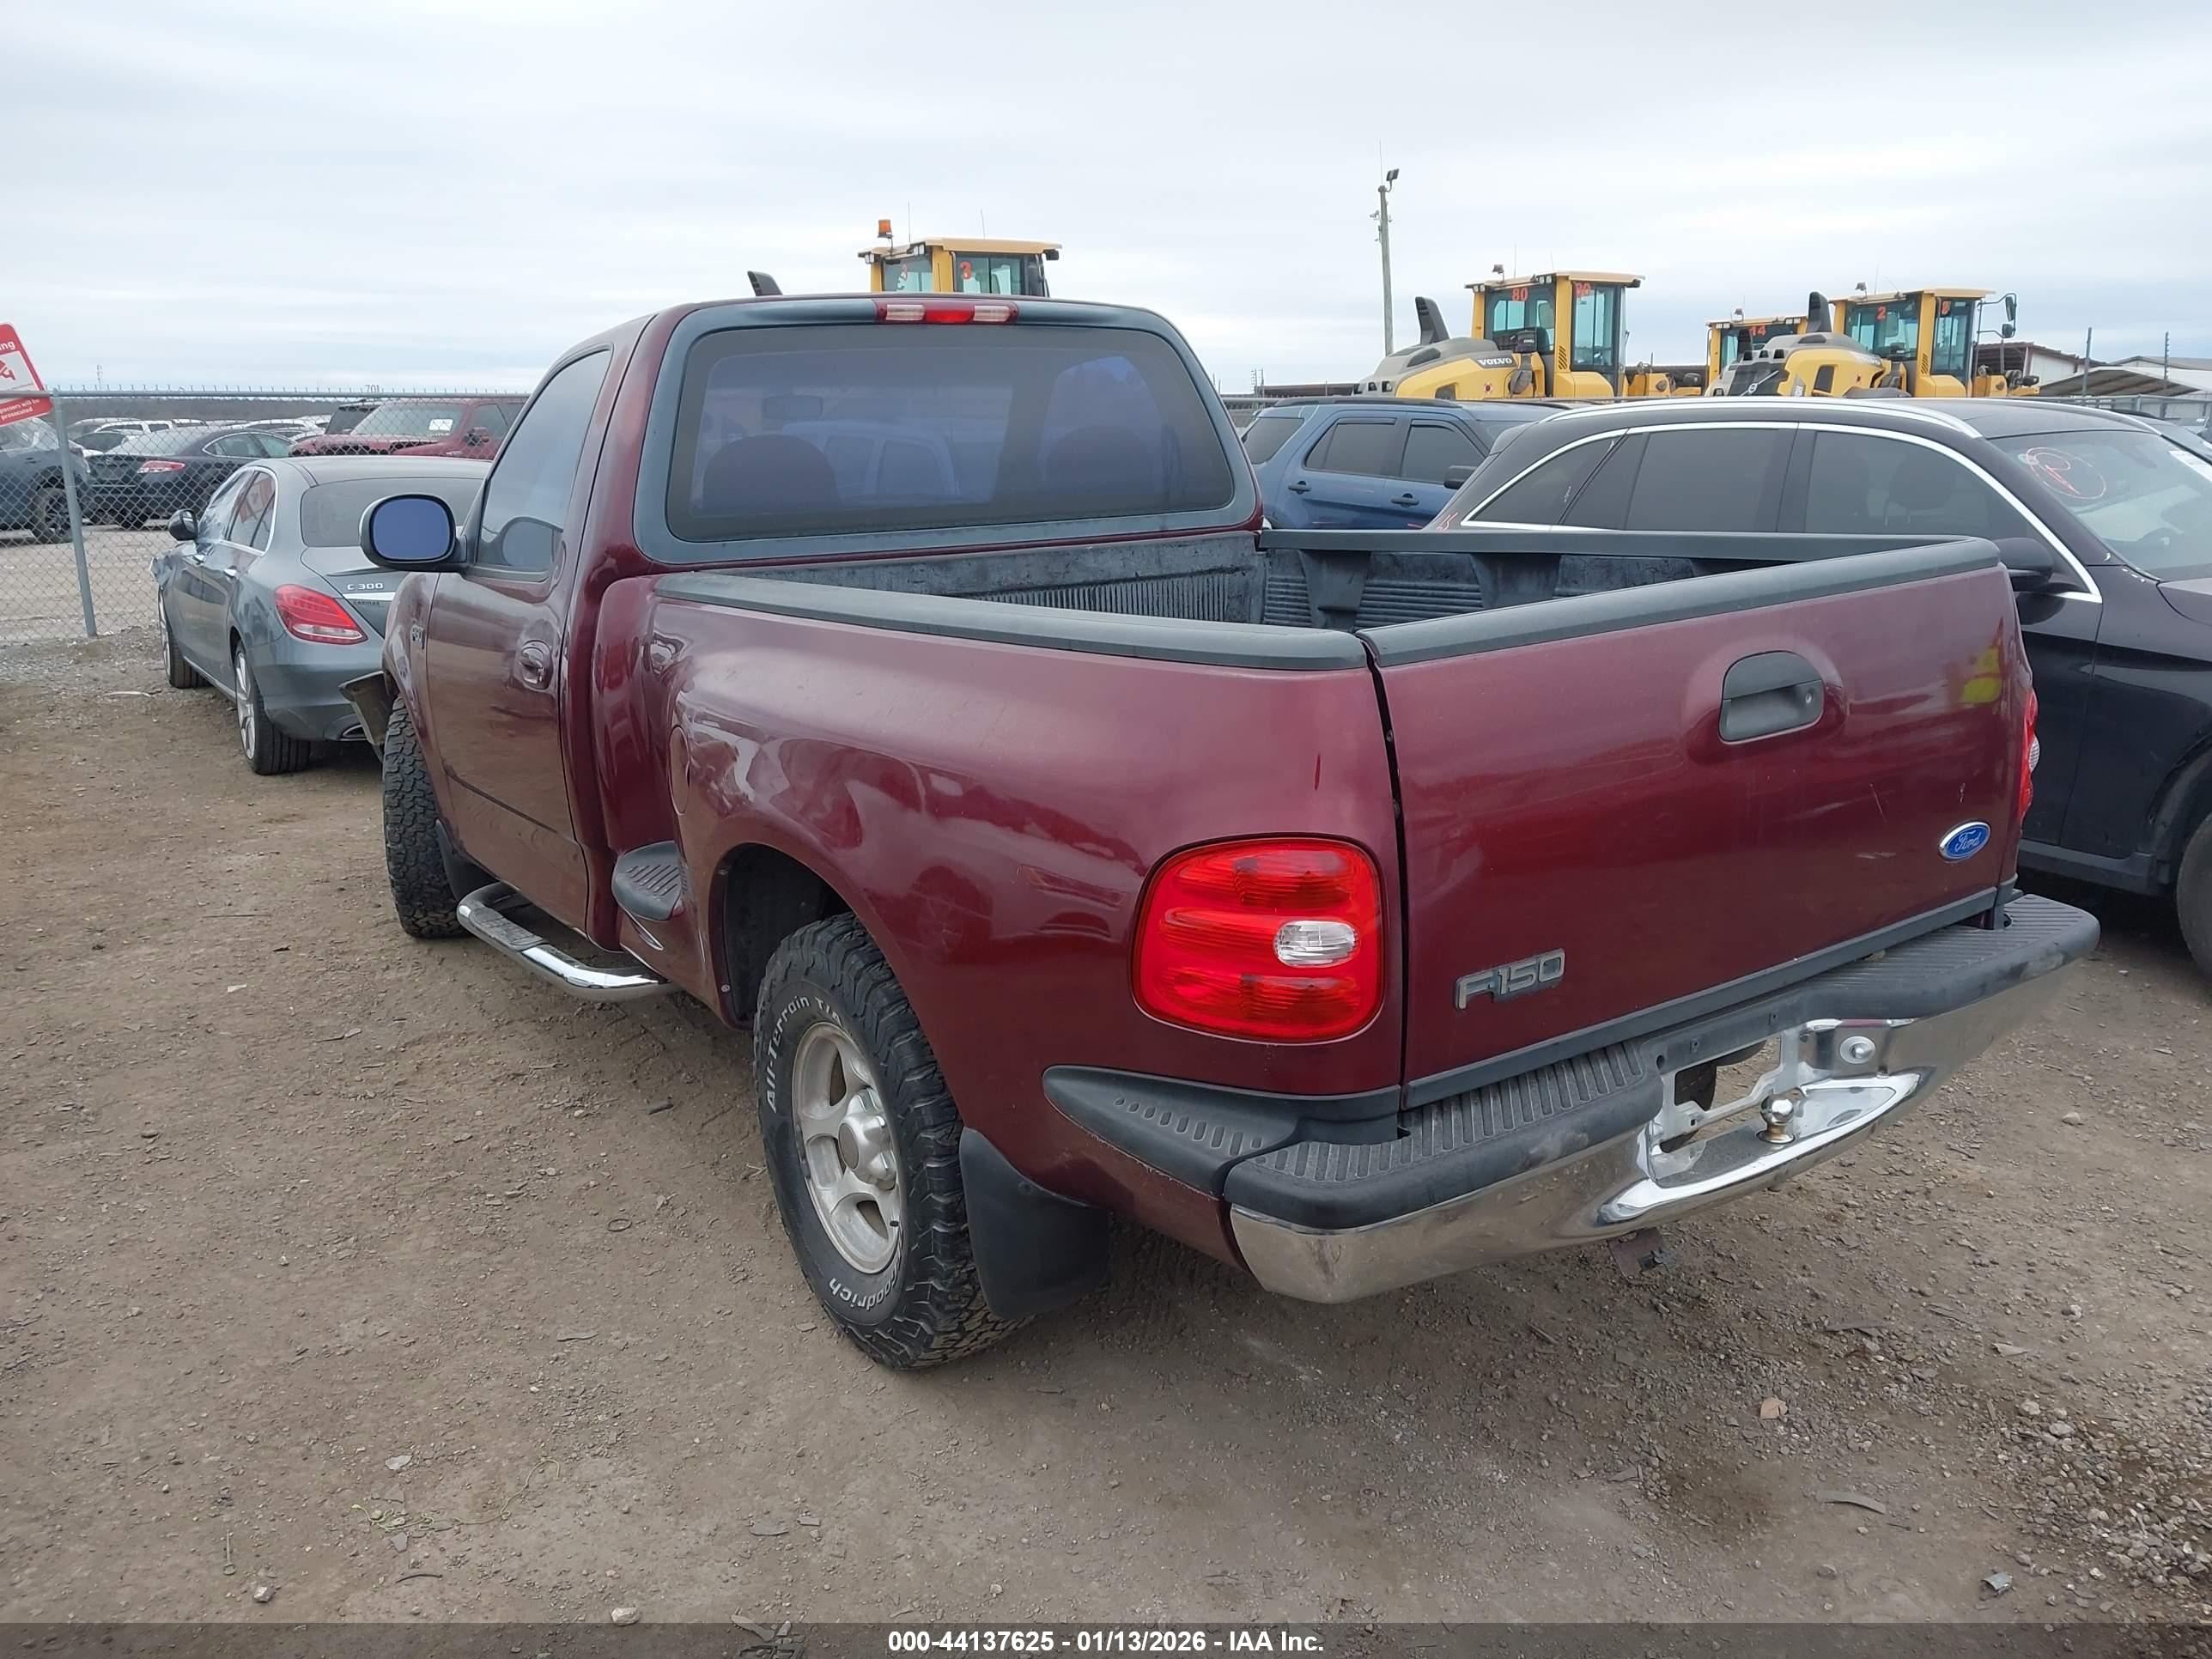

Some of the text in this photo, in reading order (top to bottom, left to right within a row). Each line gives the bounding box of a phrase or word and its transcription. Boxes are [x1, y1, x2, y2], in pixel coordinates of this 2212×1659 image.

[960, 260, 972, 279] 3
[1512, 288, 1528, 301] 80
[1877, 306, 1887, 320] 2
[1478, 357, 1513, 366] VOLVO
[358, 582, 384, 591] 300
[1954, 830, 1982, 852] Ford
[766, 995, 811, 1114] All-Terrain
